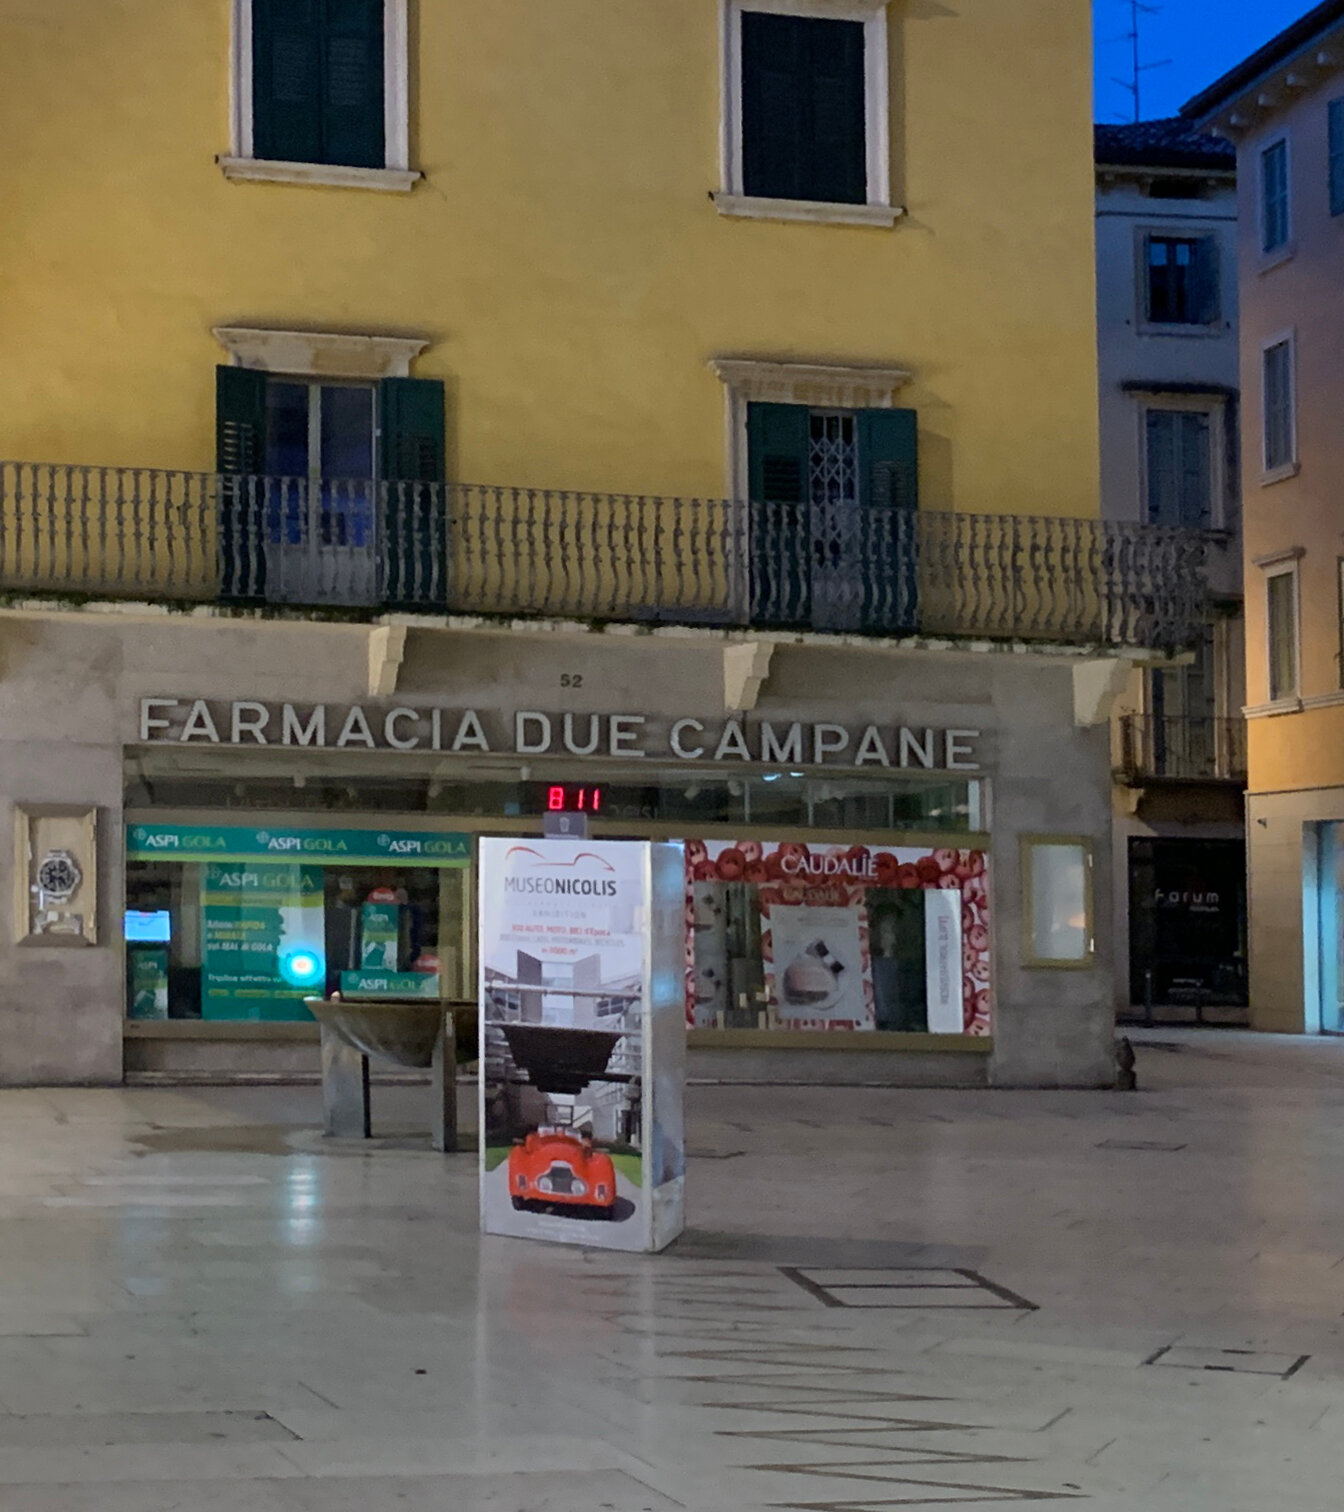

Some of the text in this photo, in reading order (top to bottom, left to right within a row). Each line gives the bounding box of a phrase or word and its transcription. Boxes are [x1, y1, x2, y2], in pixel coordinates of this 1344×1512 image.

[560, 673, 583, 688] 52
[140, 698, 981, 770] FARMACIA DUE CAMPANE
[145, 834, 226, 848] ASPI GOLA
[268, 837, 348, 851] ASPI GOLA
[388, 840, 467, 854] ASPI GOLA
[219, 872, 314, 888] ASPI GOLA
[358, 978, 388, 990] ASPI
